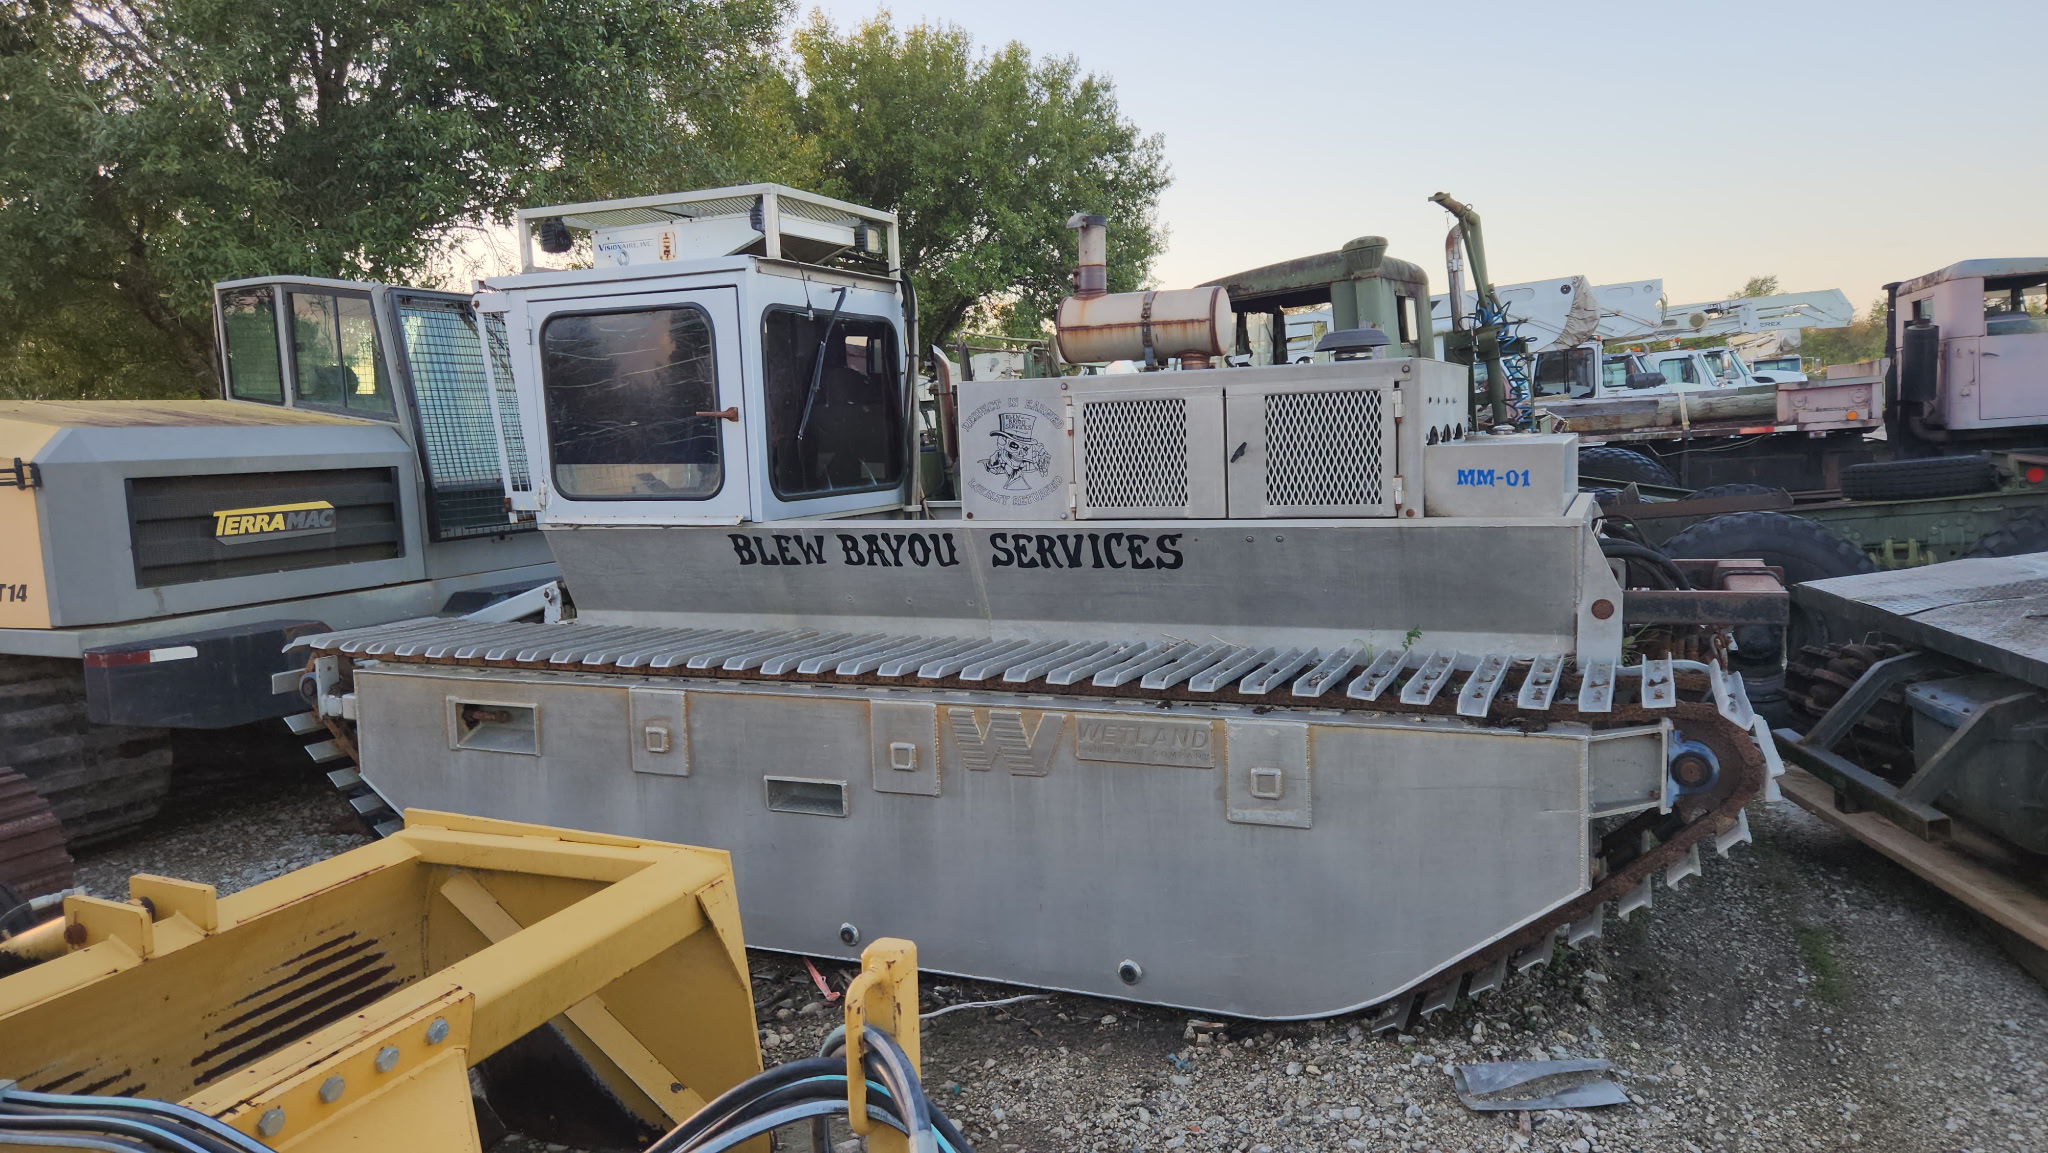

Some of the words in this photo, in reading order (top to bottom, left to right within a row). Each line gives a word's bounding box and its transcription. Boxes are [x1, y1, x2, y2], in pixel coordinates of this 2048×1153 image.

[1007, 397, 1019, 408] IS
[1024, 399, 1065, 430] EARNED
[1457, 468, 1531, 488] MM-01
[728, 533, 827, 566] BLEW
[836, 532, 960, 568] BAYOU
[990, 532, 1185, 570] SERVICES
[1078, 722, 1209, 750] WETLAND
